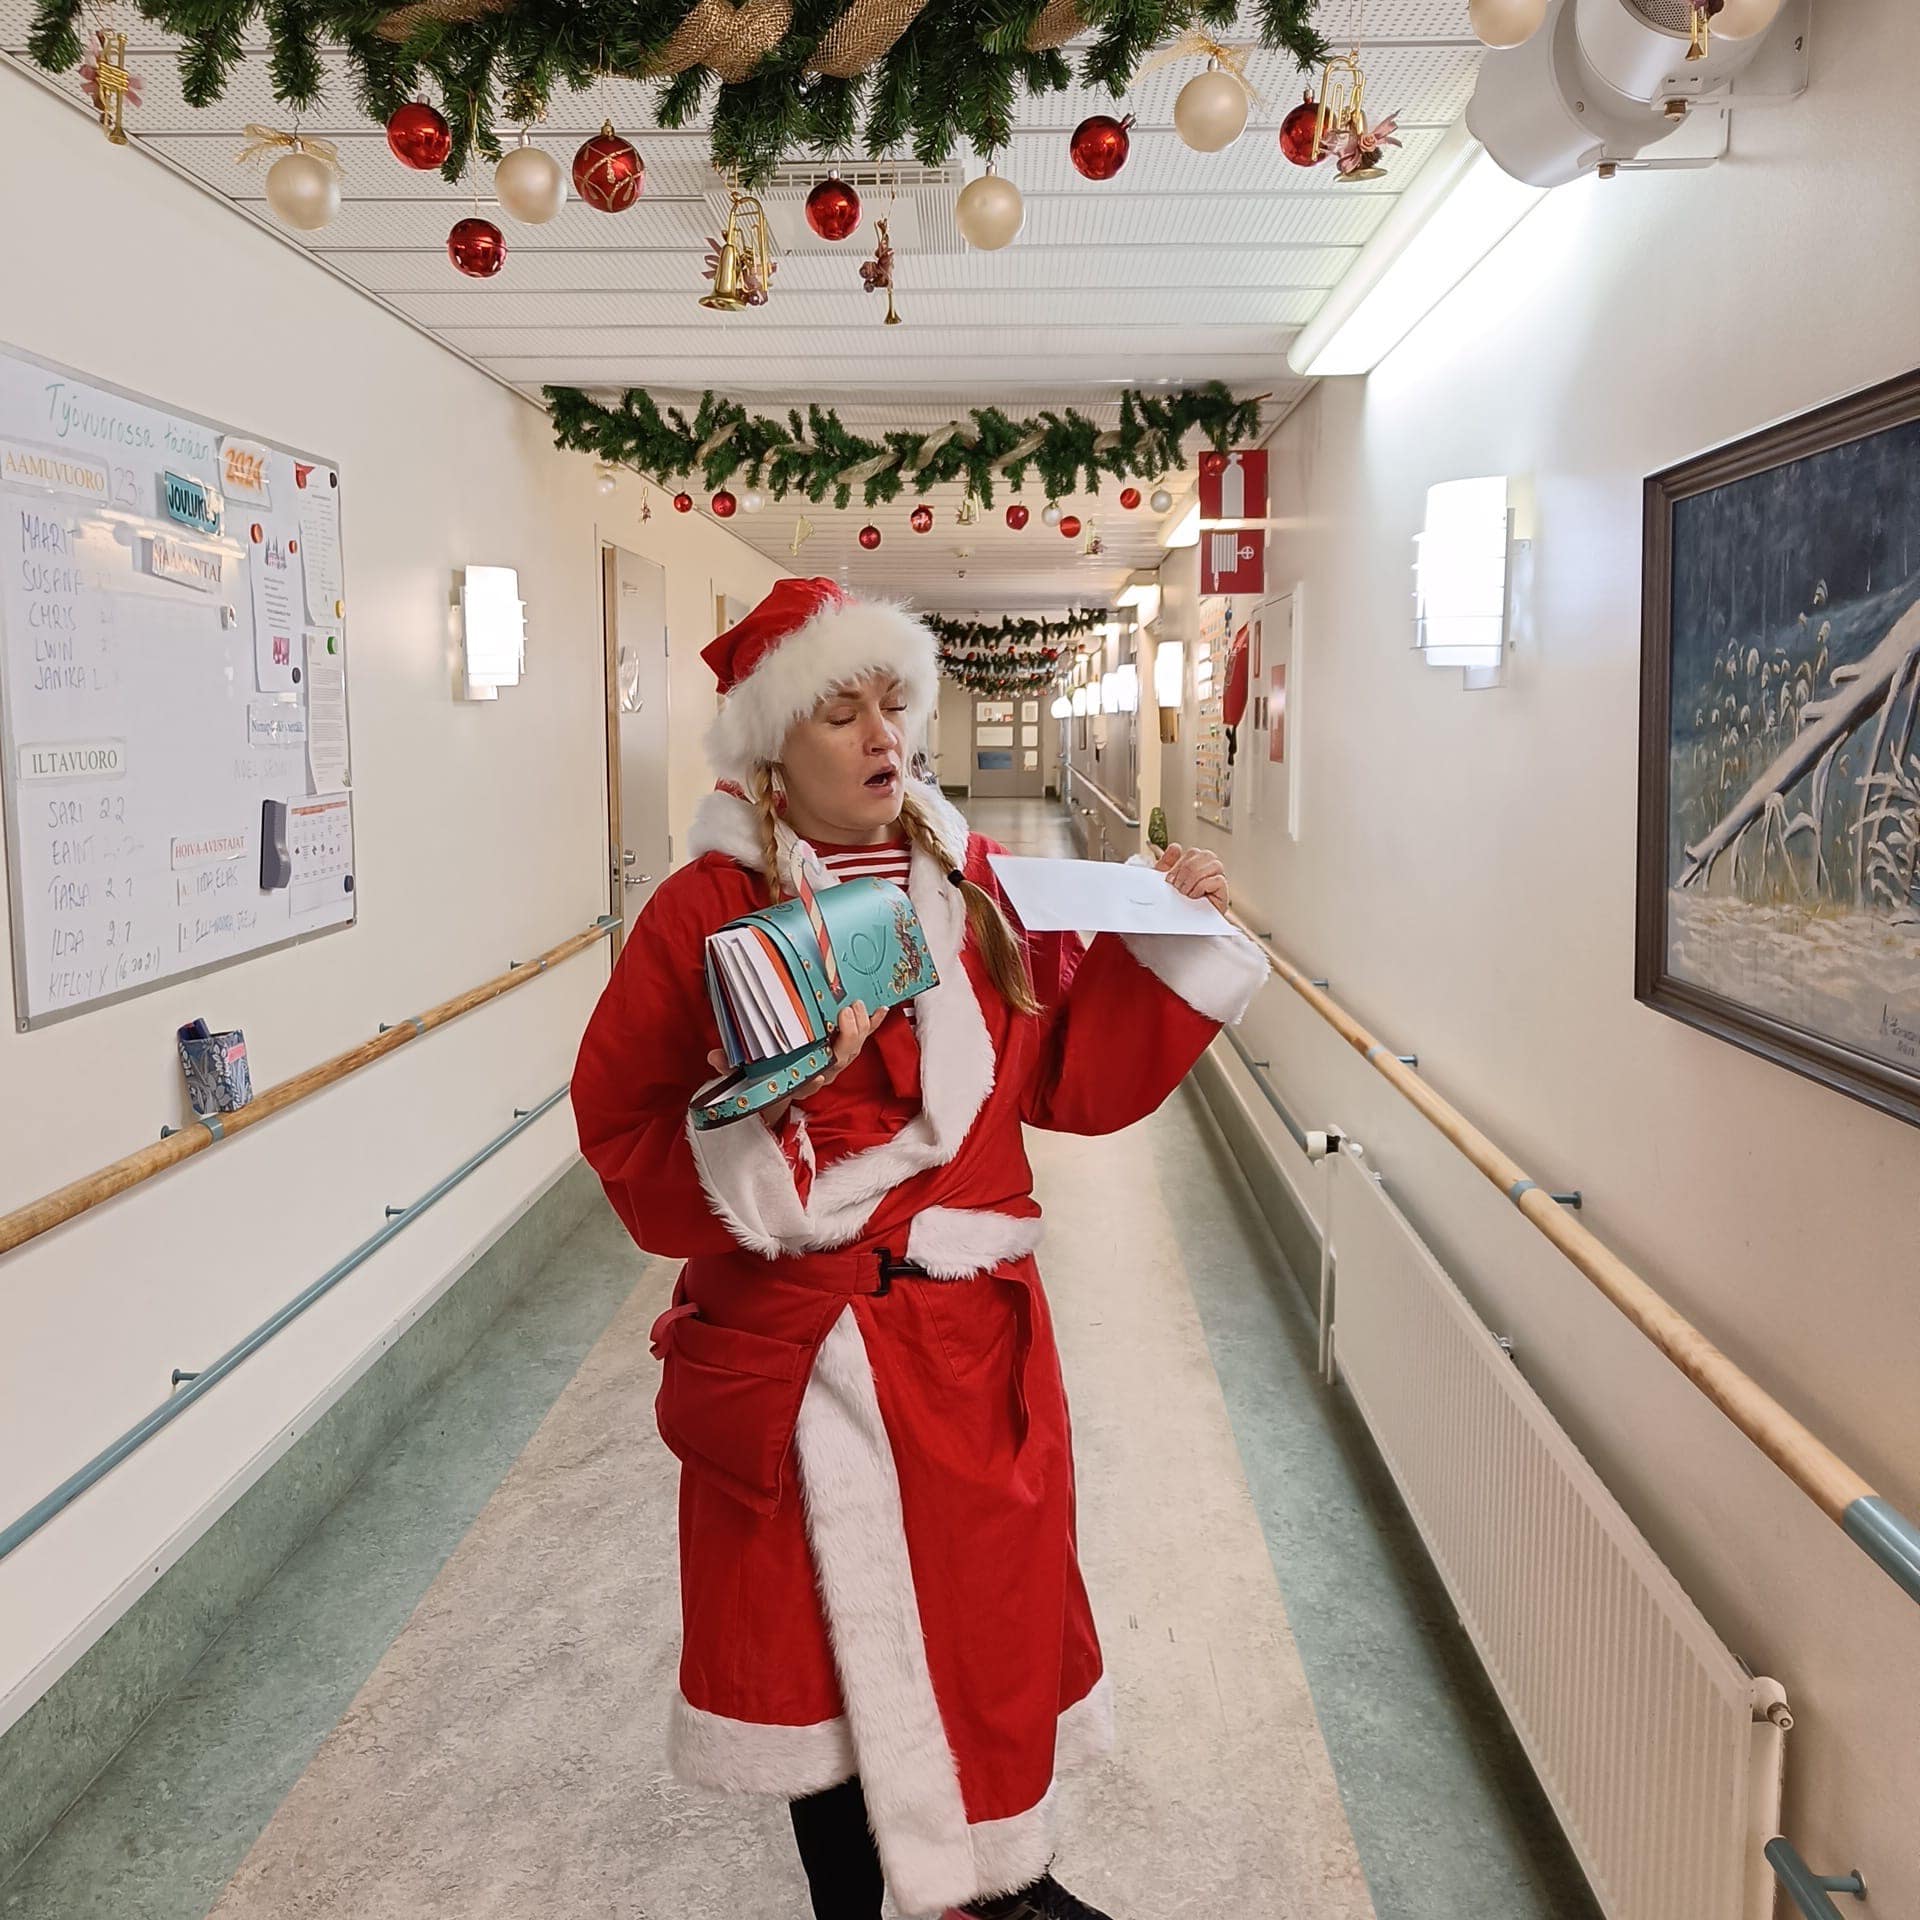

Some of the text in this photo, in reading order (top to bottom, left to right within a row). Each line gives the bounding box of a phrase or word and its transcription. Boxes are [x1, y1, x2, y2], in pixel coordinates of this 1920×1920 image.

[5, 451, 105, 492] AAMUVUORO
[153, 542, 222, 582] MAANANTAI
[29, 602, 76, 631] CHRIS
[35, 635, 73, 662] LWIN
[32, 750, 118, 774] ILTAVUORO
[48, 800, 84, 828] SARI
